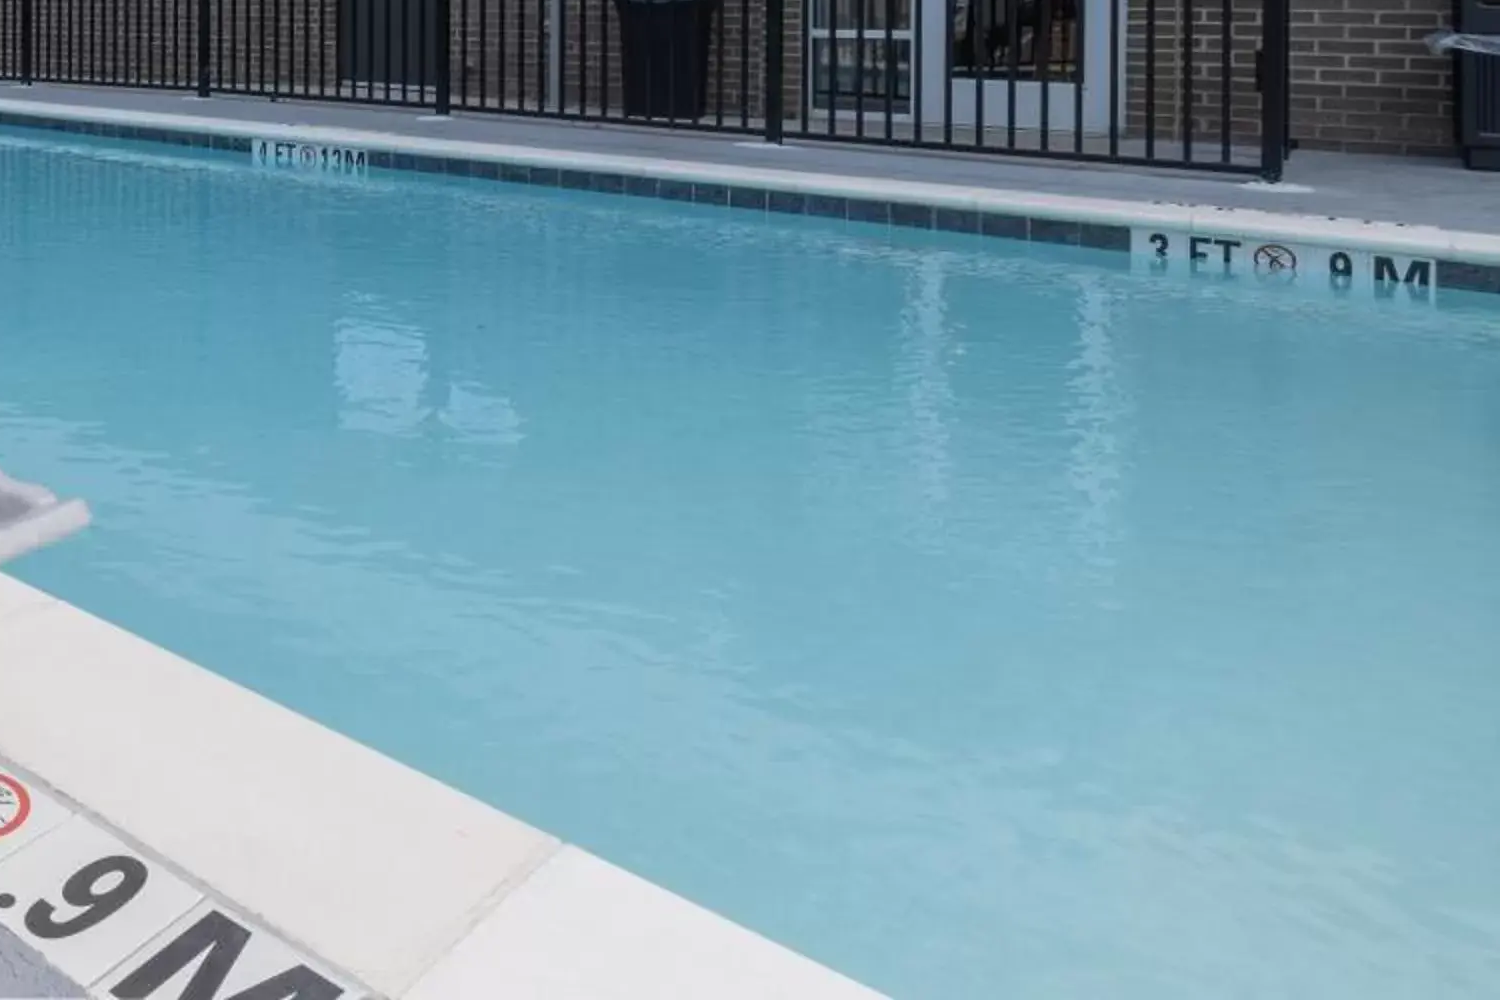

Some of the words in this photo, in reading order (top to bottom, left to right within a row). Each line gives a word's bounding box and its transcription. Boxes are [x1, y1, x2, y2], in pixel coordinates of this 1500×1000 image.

[1149, 233, 1169, 257] 3
[1190, 236, 1241, 264] FT
[1373, 256, 1431, 286] M
[108, 909, 345, 1000] M
